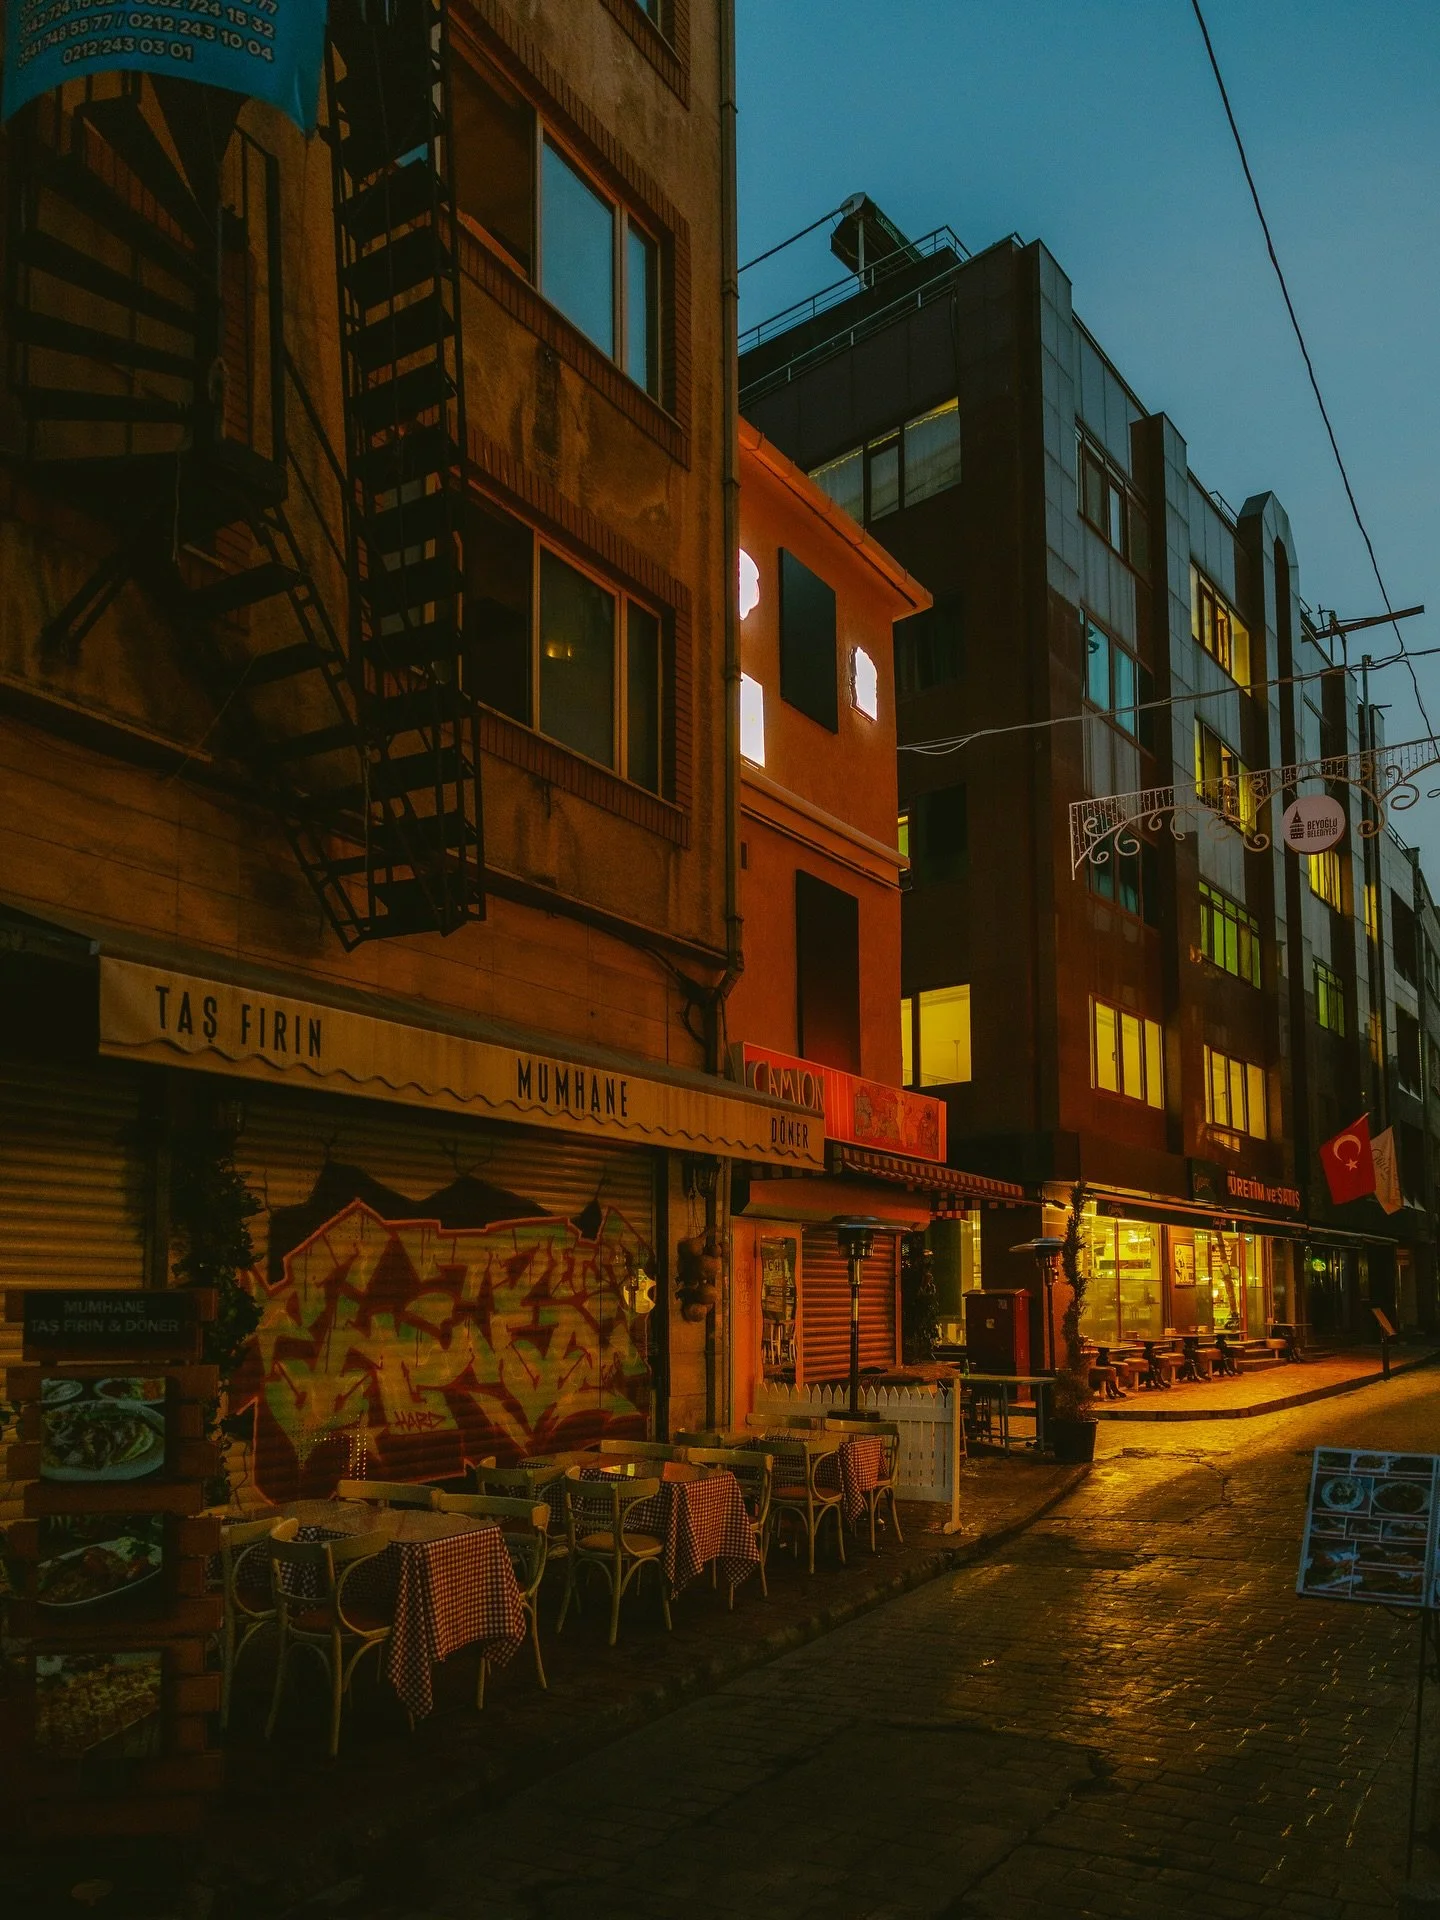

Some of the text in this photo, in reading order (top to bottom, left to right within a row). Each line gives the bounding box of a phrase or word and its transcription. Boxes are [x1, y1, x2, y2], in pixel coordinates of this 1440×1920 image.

[70, 20, 89, 36] 55
[93, 14, 113, 30] 77
[129, 13, 175, 31] 0212
[179, 20, 216, 39] 243
[221, 30, 243, 48] 10
[247, 40, 273, 60] 04
[227, 7, 247, 25] 15
[251, 16, 274, 38] 32
[63, 37, 192, 63] 0212 243 03 01
[155, 984, 810, 1150] TAŞ FIRIN MUMHANE DÖNER
[1226, 1170, 1265, 1200] ÜRETİM
[63, 1300, 146, 1314] MUMHANE
[30, 1317, 179, 1336] TAŞ FIRIN & DÖNER
